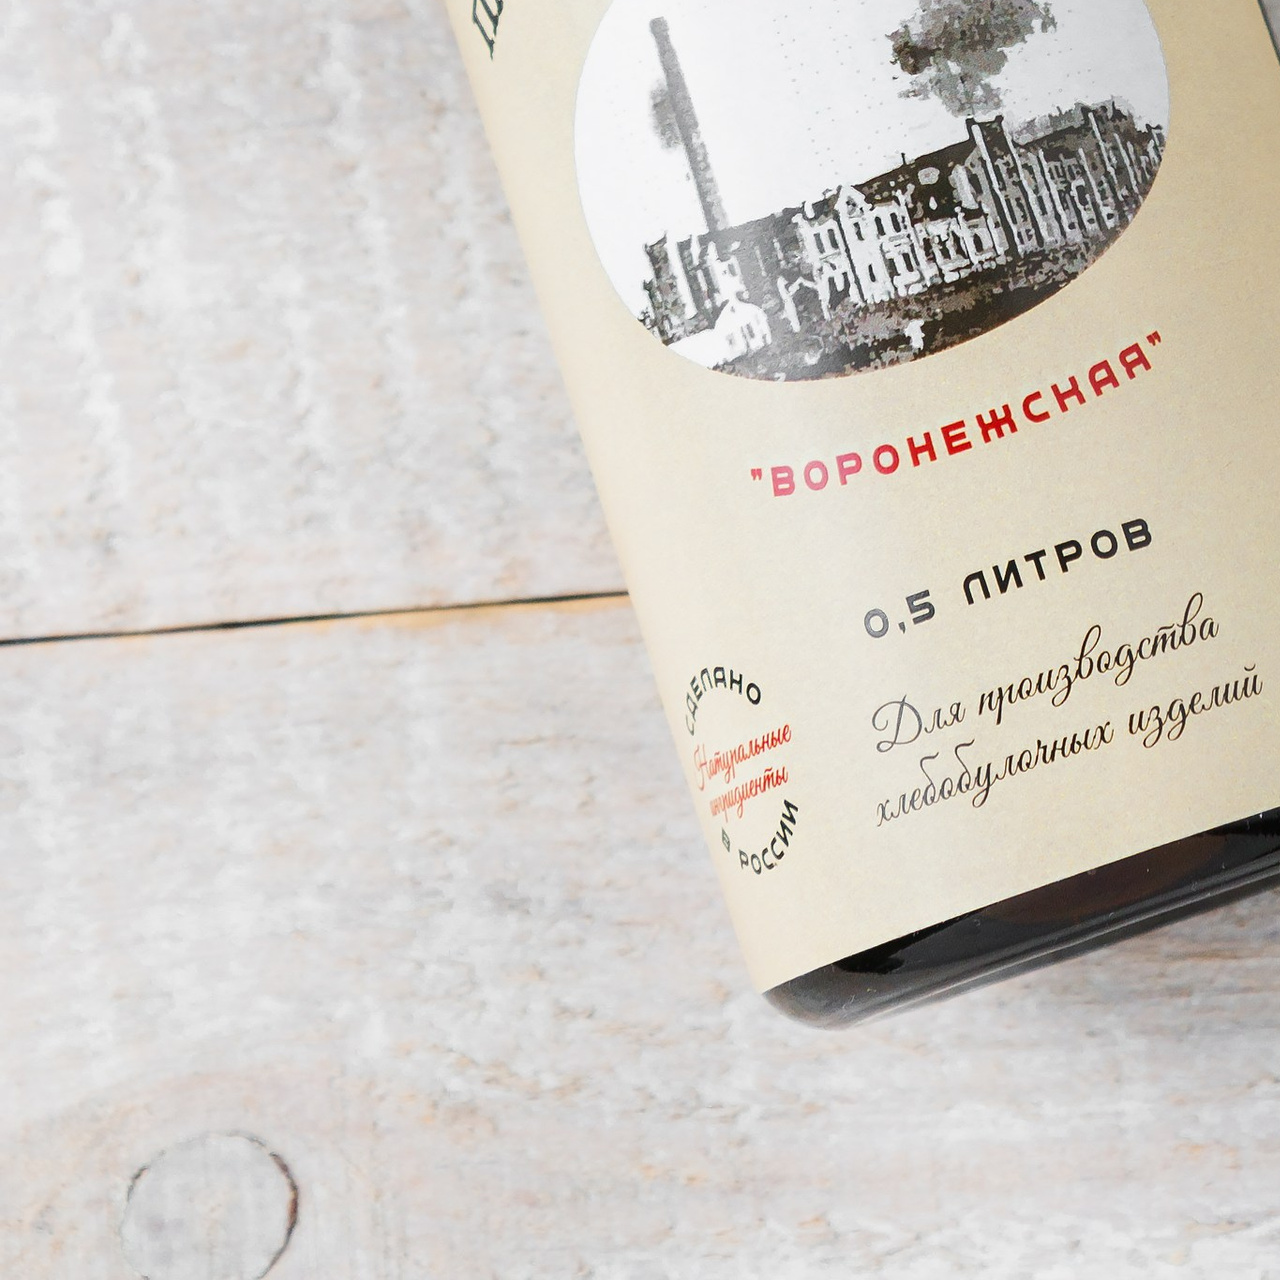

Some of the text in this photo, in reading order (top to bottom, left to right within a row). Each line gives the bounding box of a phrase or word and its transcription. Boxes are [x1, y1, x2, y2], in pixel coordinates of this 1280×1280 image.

[863, 516, 1154, 640] 0,5 ЛИТРОВ
[685, 666, 762, 736] СДЕЛАНО
[871, 591, 1221, 754] Для производства
[694, 723, 792, 791] Натуральные
[873, 663, 1264, 828] хлебобулочных изделий
[738, 798, 799, 875] РОССИИ
